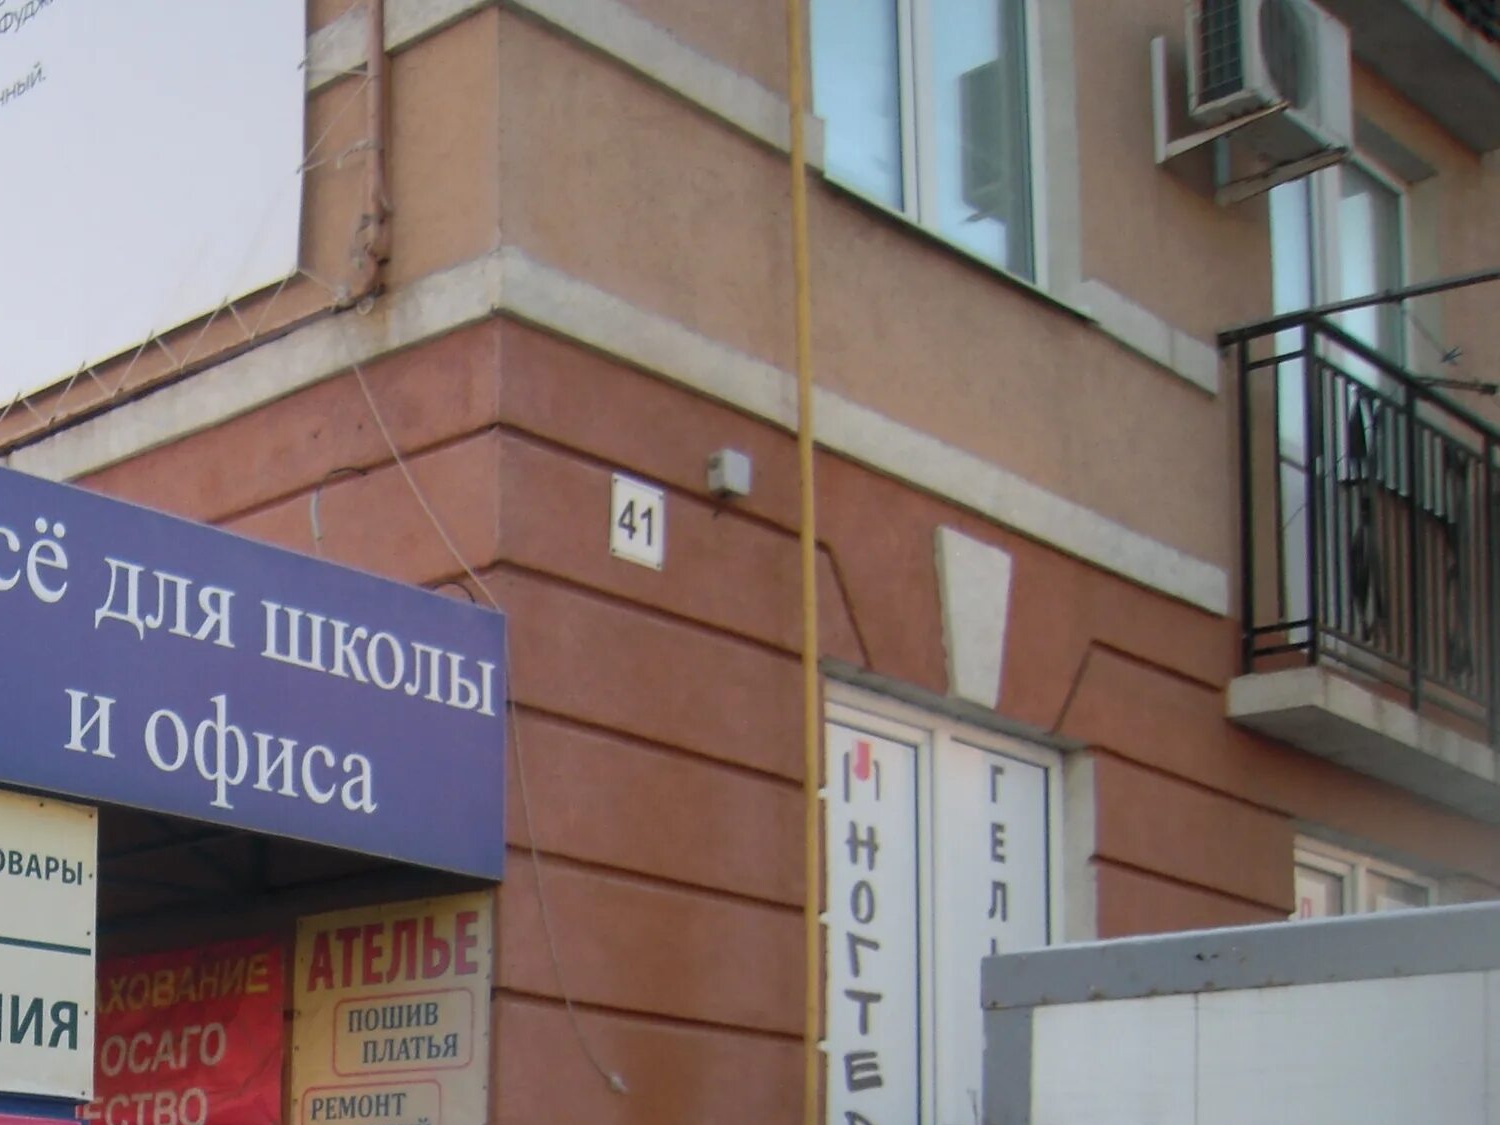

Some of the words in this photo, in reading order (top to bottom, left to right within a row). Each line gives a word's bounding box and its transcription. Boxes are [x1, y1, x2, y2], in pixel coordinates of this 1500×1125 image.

[616, 499, 657, 550] 41
[95, 557, 236, 649] для
[261, 600, 496, 717] школы
[65, 688, 117, 759] и
[144, 695, 377, 814] офиса
[307, 910, 479, 993] АТЕЛЬЕ
[98, 953, 270, 1015] ХОВАНИЕ
[347, 1002, 439, 1034] ПОШИВ
[101, 1022, 227, 1077] ОСАГО
[361, 1033, 459, 1065] ПЛАТЬЯ
[310, 1093, 406, 1121] РЕМОНТ
